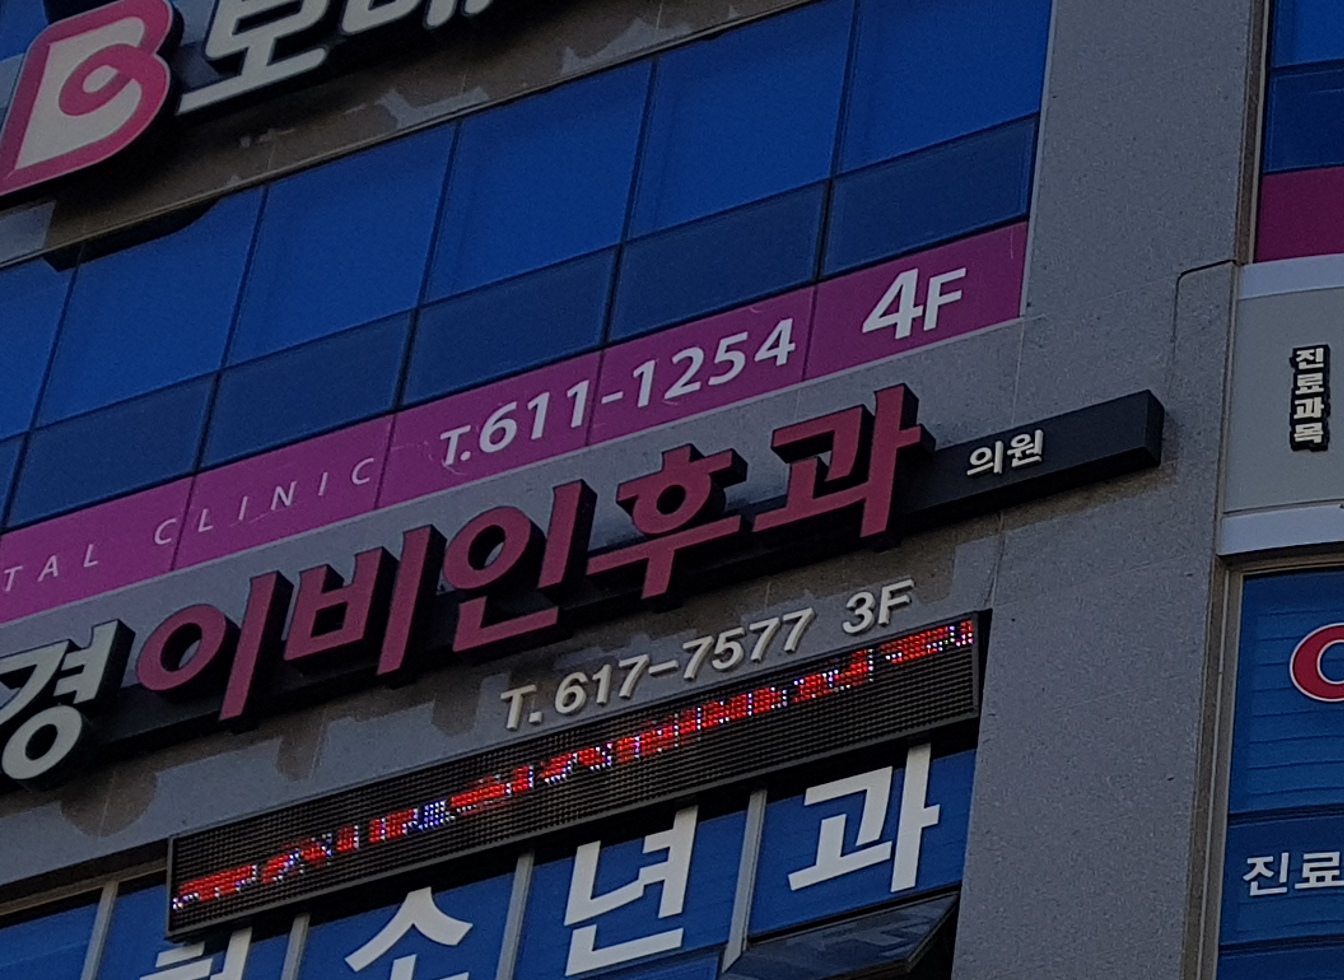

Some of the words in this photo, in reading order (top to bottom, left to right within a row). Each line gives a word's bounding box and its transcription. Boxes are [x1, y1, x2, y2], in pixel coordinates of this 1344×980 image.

[153, 457, 376, 547] CLINIC
[861, 267, 967, 340] 4F
[1293, 346, 1326, 445] 진료과목
[966, 428, 1046, 477] 의원
[841, 577, 916, 635] 3F
